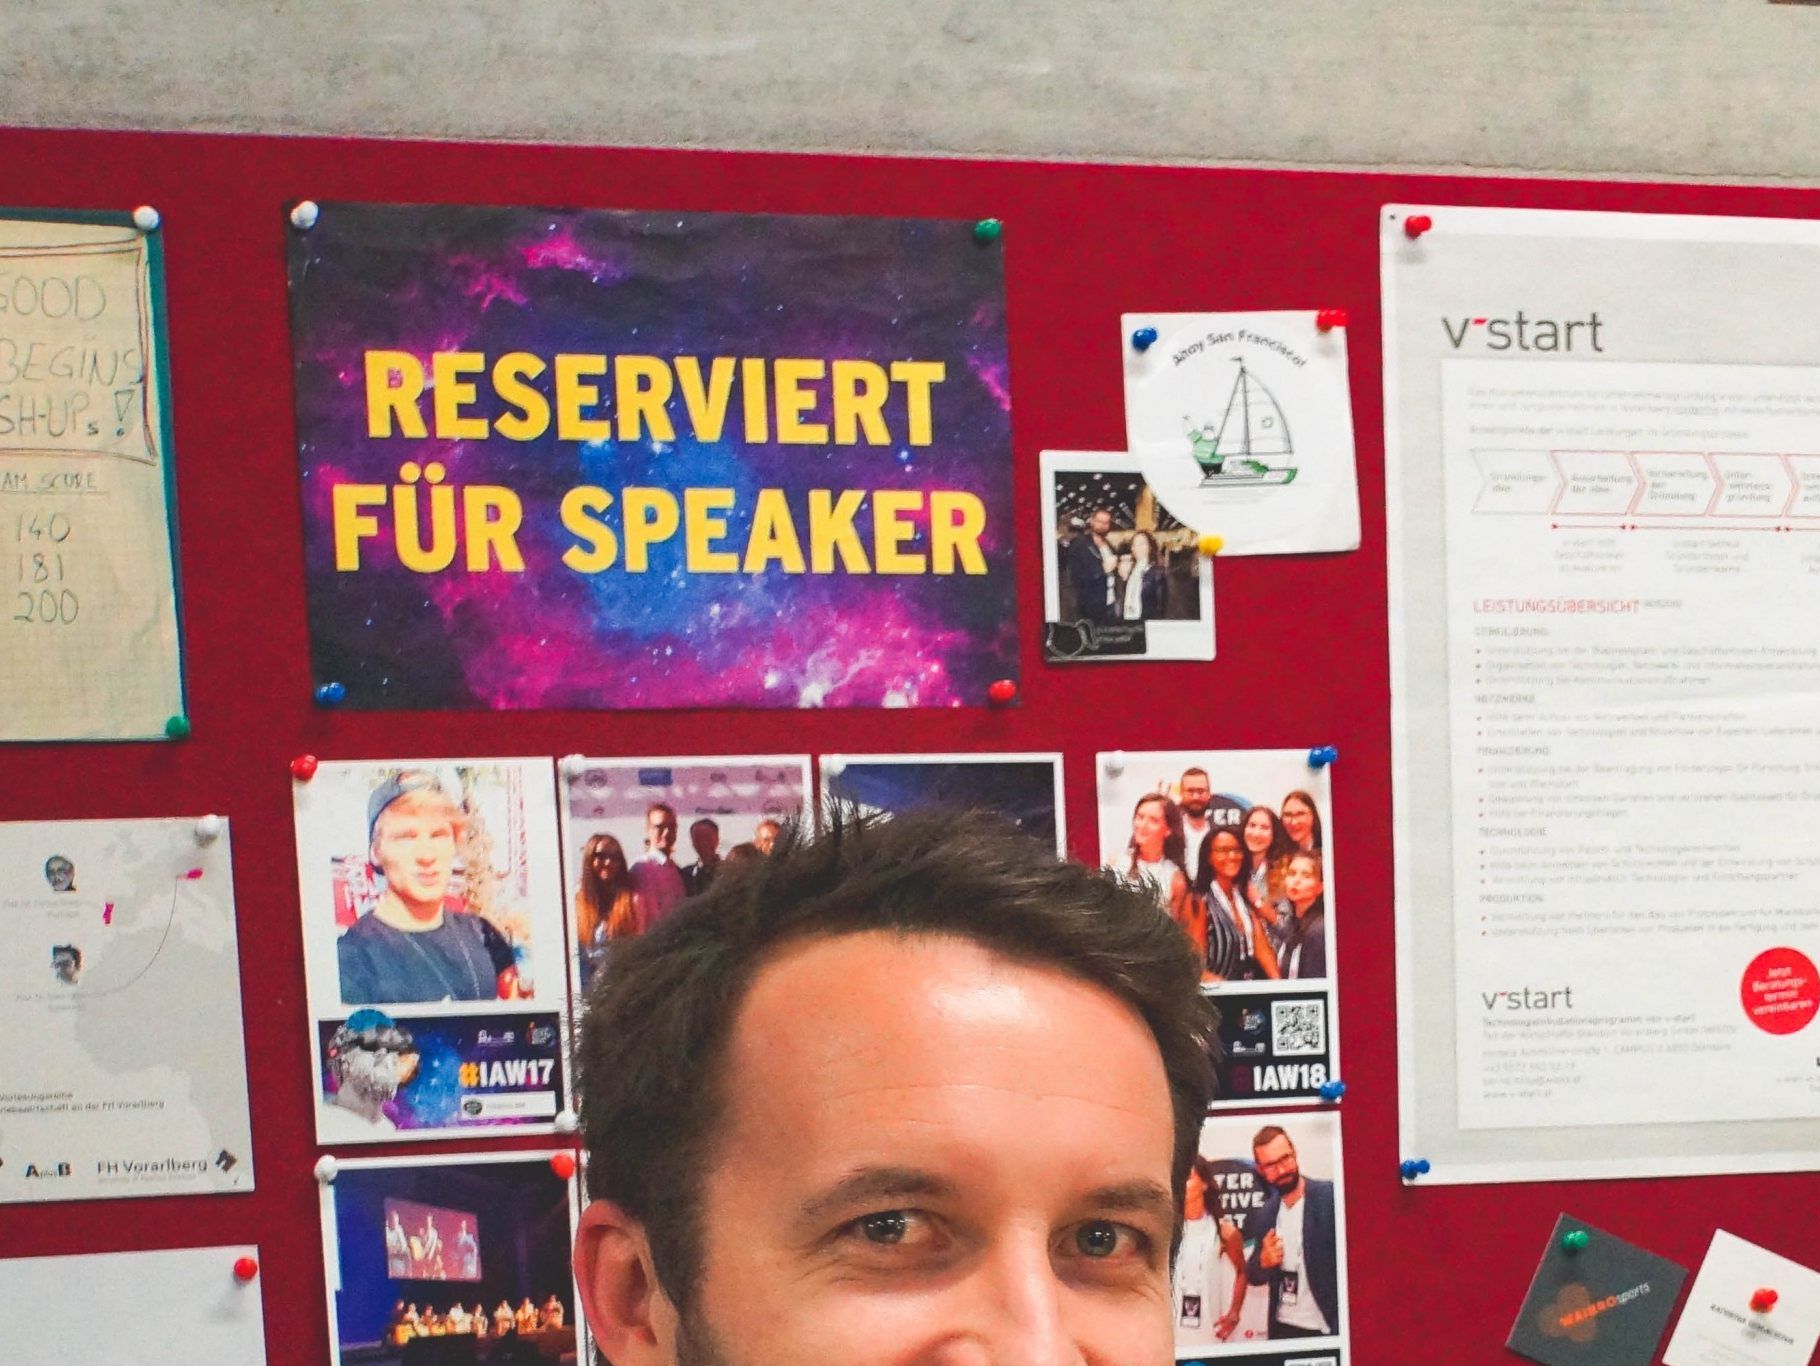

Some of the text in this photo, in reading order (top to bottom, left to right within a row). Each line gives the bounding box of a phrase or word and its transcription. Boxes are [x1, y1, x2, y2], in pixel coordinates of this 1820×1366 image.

[1206, 332, 1234, 345] San
[364, 350, 945, 446] RESERVIERT
[16, 514, 71, 543] 140
[332, 461, 988, 576] FÜR SPEAKER
[19, 553, 64, 583] 181
[14, 589, 79, 625] 200
[1473, 596, 1640, 614] LEISTUNGSÜBERSICHT
[459, 1057, 555, 1088] #IAW17
[97, 1160, 118, 1174] FH
[123, 1158, 207, 1174] Vorarlberg
